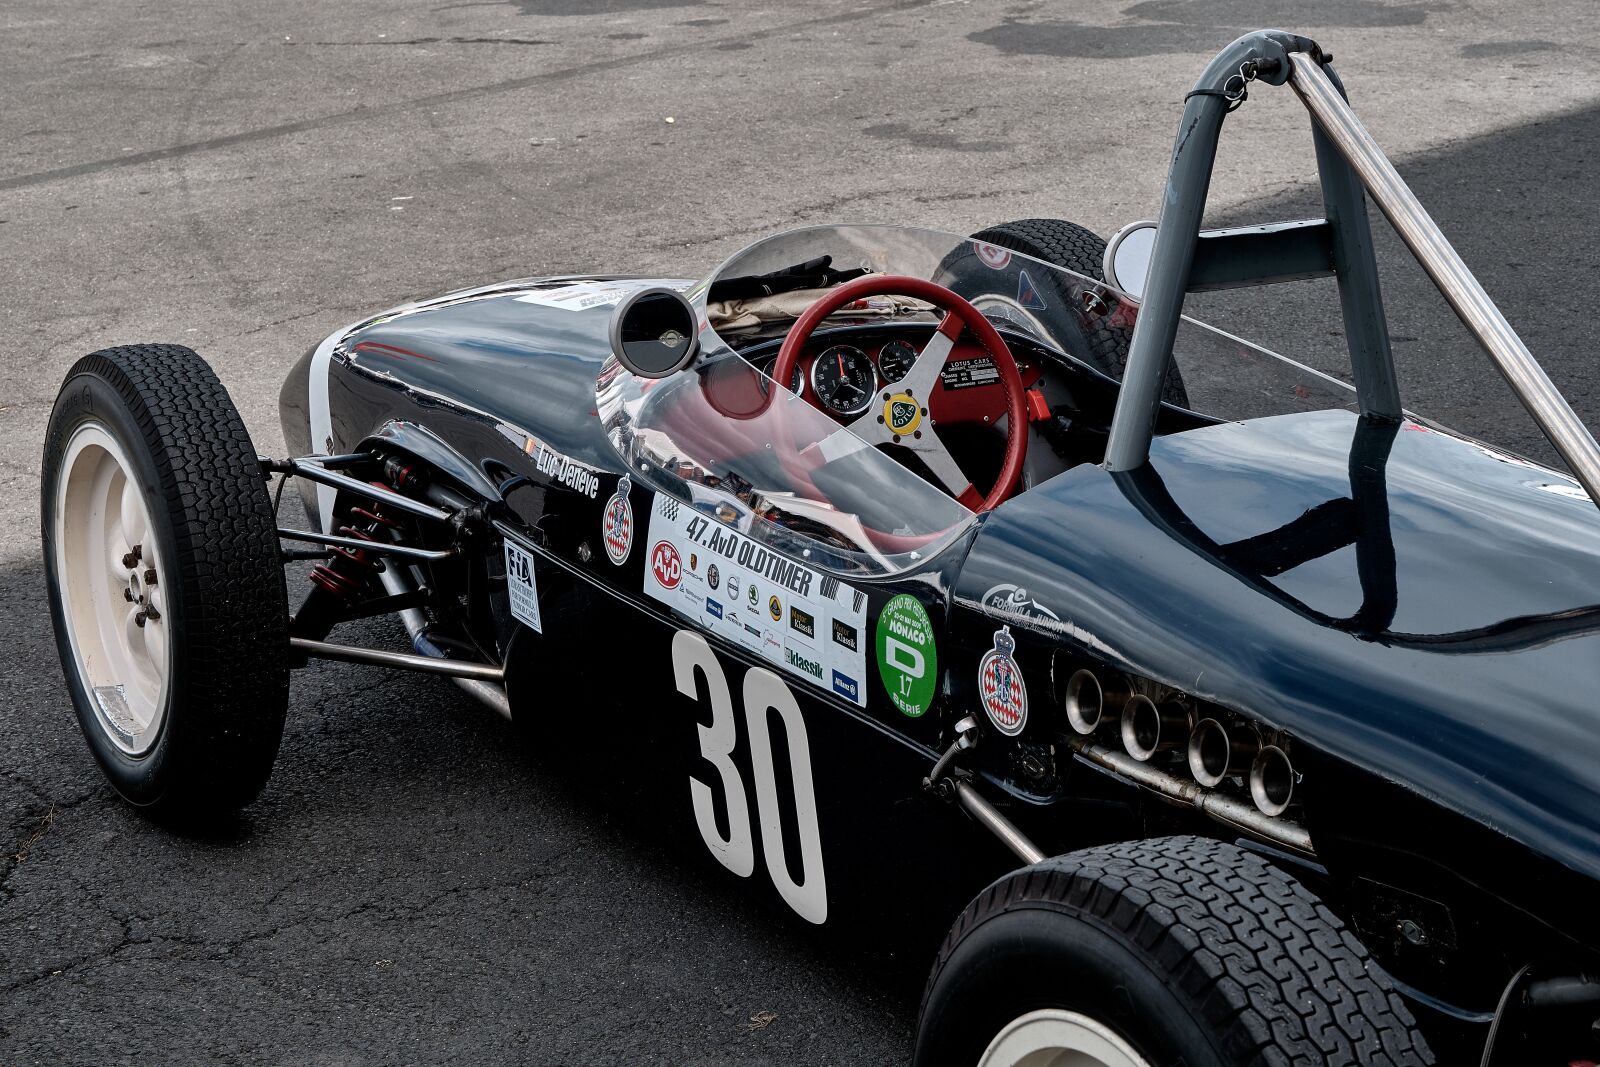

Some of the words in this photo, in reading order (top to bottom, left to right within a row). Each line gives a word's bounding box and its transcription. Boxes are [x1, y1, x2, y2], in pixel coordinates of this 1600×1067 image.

[951, 360, 970, 368] LOTUS
[893, 405, 915, 426] LOTUS
[536, 444, 558, 477] Luc
[686, 516, 708, 546] 47.
[708, 526, 739, 559] AvD
[737, 540, 813, 598] OLDTIMER
[794, 618, 812, 636] Klassik
[834, 621, 850, 636] Motor
[992, 596, 1030, 619] FORMULA
[1034, 614, 1064, 634] JUNIOR
[836, 632, 856, 649] Klassik
[890, 619, 925, 646] MONACO
[790, 649, 823, 680] klassik
[886, 636, 925, 678] D
[900, 674, 912, 698] 17
[671, 630, 828, 925] 30
